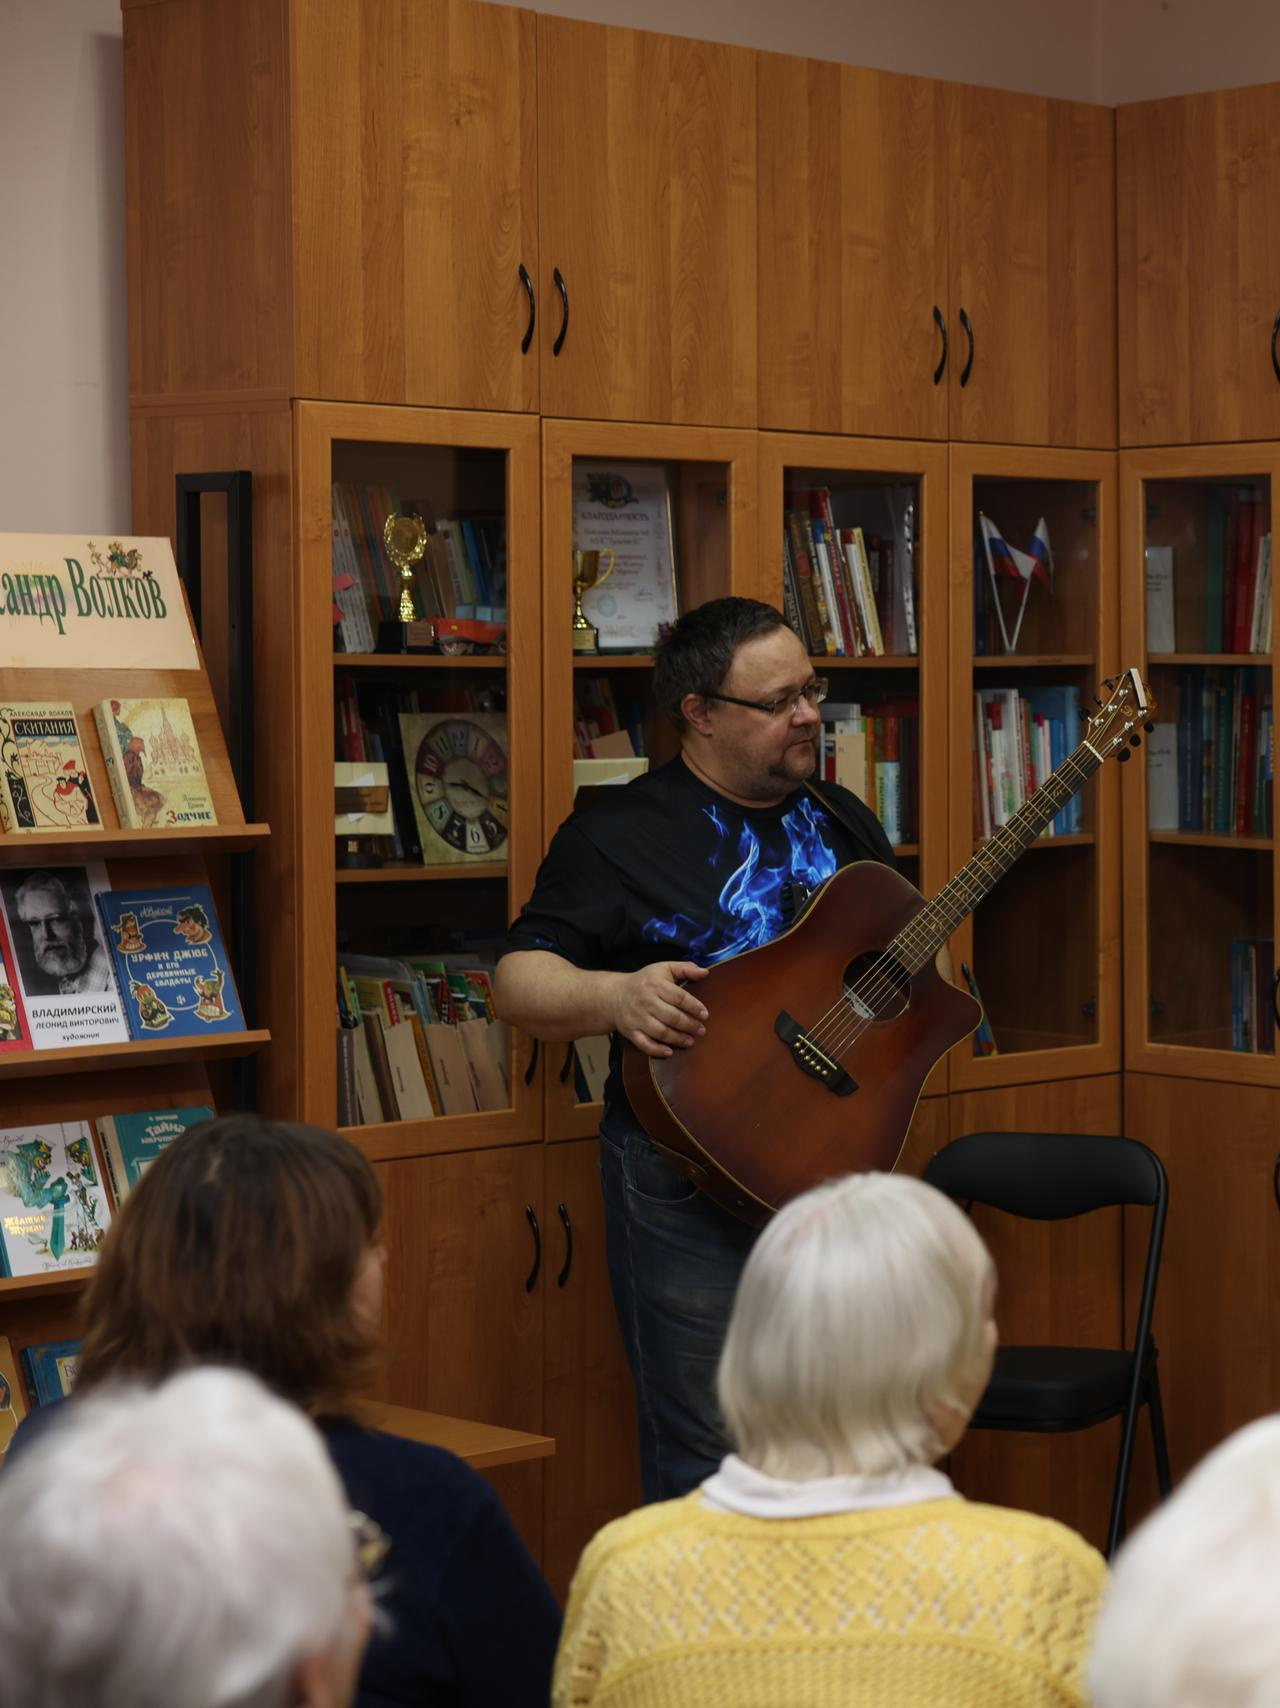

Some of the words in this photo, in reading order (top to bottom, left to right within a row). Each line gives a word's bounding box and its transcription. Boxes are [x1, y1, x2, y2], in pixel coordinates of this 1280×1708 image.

[0, 572, 67, 635] андр
[64, 557, 168, 620] Волков
[14, 721, 75, 735] СКИТАНИЯ
[154, 978, 192, 987] СОЛДАТЫ
[32, 1003, 117, 1018] ВЛАДИМИРСКИЙ
[36, 1021, 68, 1029] ЛЕОНИД
[69, 1017, 119, 1027] ВИКТОРОВИЧ
[62, 1033, 100, 1041] художник
